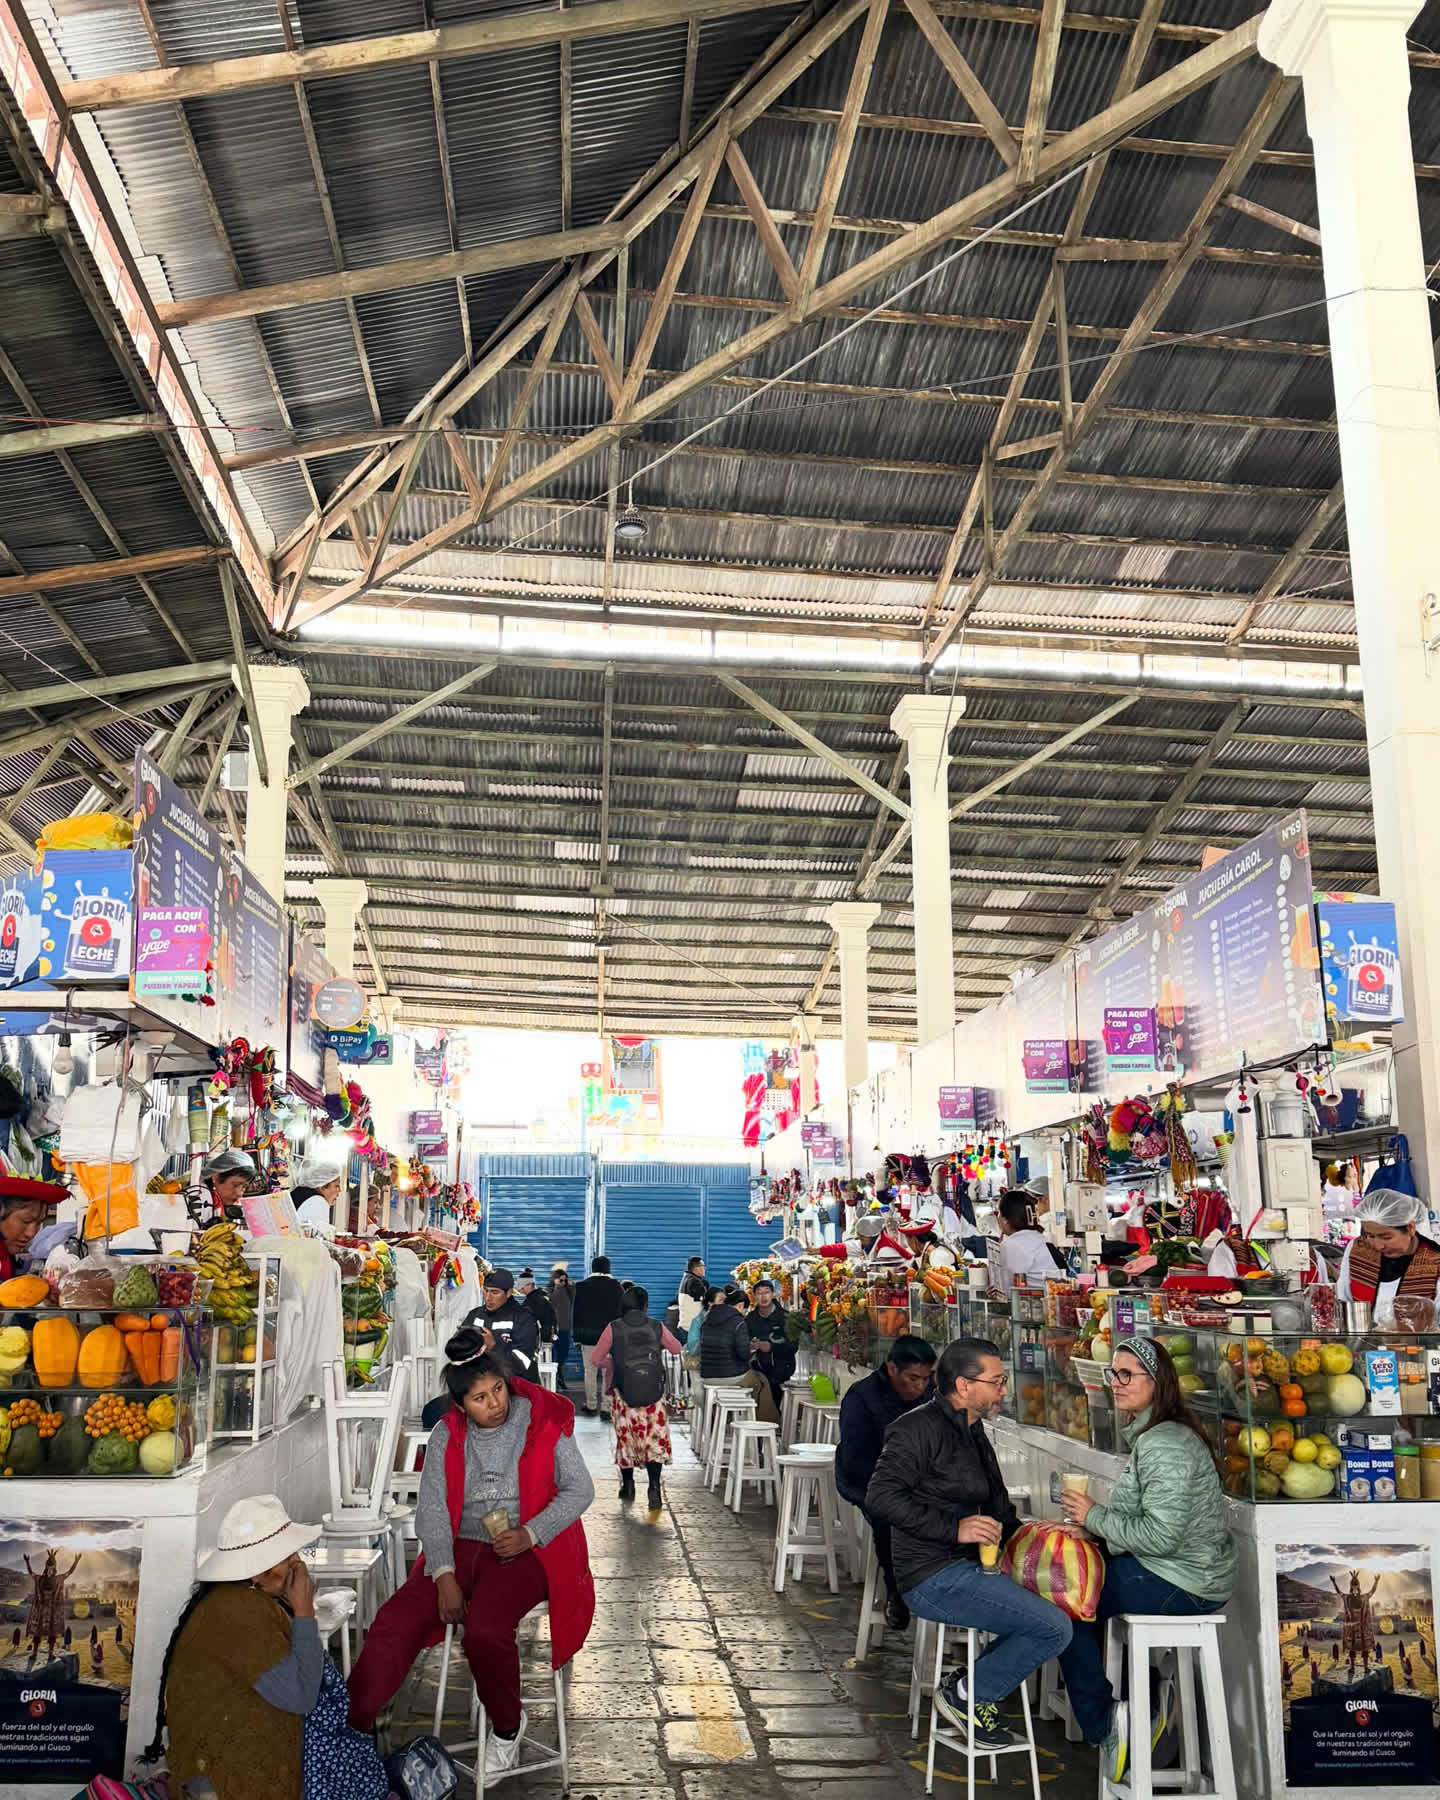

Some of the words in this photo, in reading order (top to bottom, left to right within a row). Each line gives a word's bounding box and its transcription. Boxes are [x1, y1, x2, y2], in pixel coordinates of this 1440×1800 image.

[1198, 866, 1236, 905] JUGUERÍA
[1233, 847, 1263, 879] CAROL
[72, 900, 127, 926] GLORIA
[142, 911, 172, 921] PAGA
[174, 909, 202, 922] AQUÍ
[174, 924, 197, 934] CON
[0, 947, 17, 966] ECHE
[71, 944, 115, 961] LECHE
[138, 939, 171, 963] yape
[1350, 948, 1396, 976] GLORIA
[1352, 988, 1390, 1005] LECHE
[1107, 1010, 1128, 1018] PAGA
[1128, 1009, 1148, 1019] AQUÍ
[1111, 1020, 1128, 1028] CON
[339, 1035, 363, 1045] BiPay
[1127, 1032, 1149, 1049] yape
[1371, 1361, 1394, 1371] zero
[20, 1689, 58, 1704] GLORIA
[1345, 1700, 1379, 1713] GLORIA
[2, 1722, 26, 1730] fuerza
[27, 1722, 40, 1730] del
[41, 1722, 52, 1730] sol
[59, 1722, 66, 1731] el
[67, 1722, 95, 1733] orgullo
[26, 1734, 69, 1742] tradiciones
[69, 1733, 90, 1742] sigan
[1312, 1730, 1327, 1739] Que
[1327, 1730, 1334, 1738] la
[1334, 1730, 1356, 1738] fuerza
[1357, 1730, 1368, 1738] del
[1368, 1729, 1378, 1738] sol
[1383, 1729, 1390, 1738] el
[1390, 1729, 1415, 1739] orgullo
[39, 1743, 46, 1751] al
[47, 1742, 71, 1751] Cusco
[1316, 1739, 1326, 1747] de
[1326, 1740, 1356, 1748] nuestras
[1355, 1739, 1393, 1748] tradiciones
[1393, 1739, 1411, 1749] sigan
[1332, 1748, 1369, 1757] iluminando
[1368, 1749, 1376, 1757] al
[1375, 1748, 1397, 1757] Cusco
